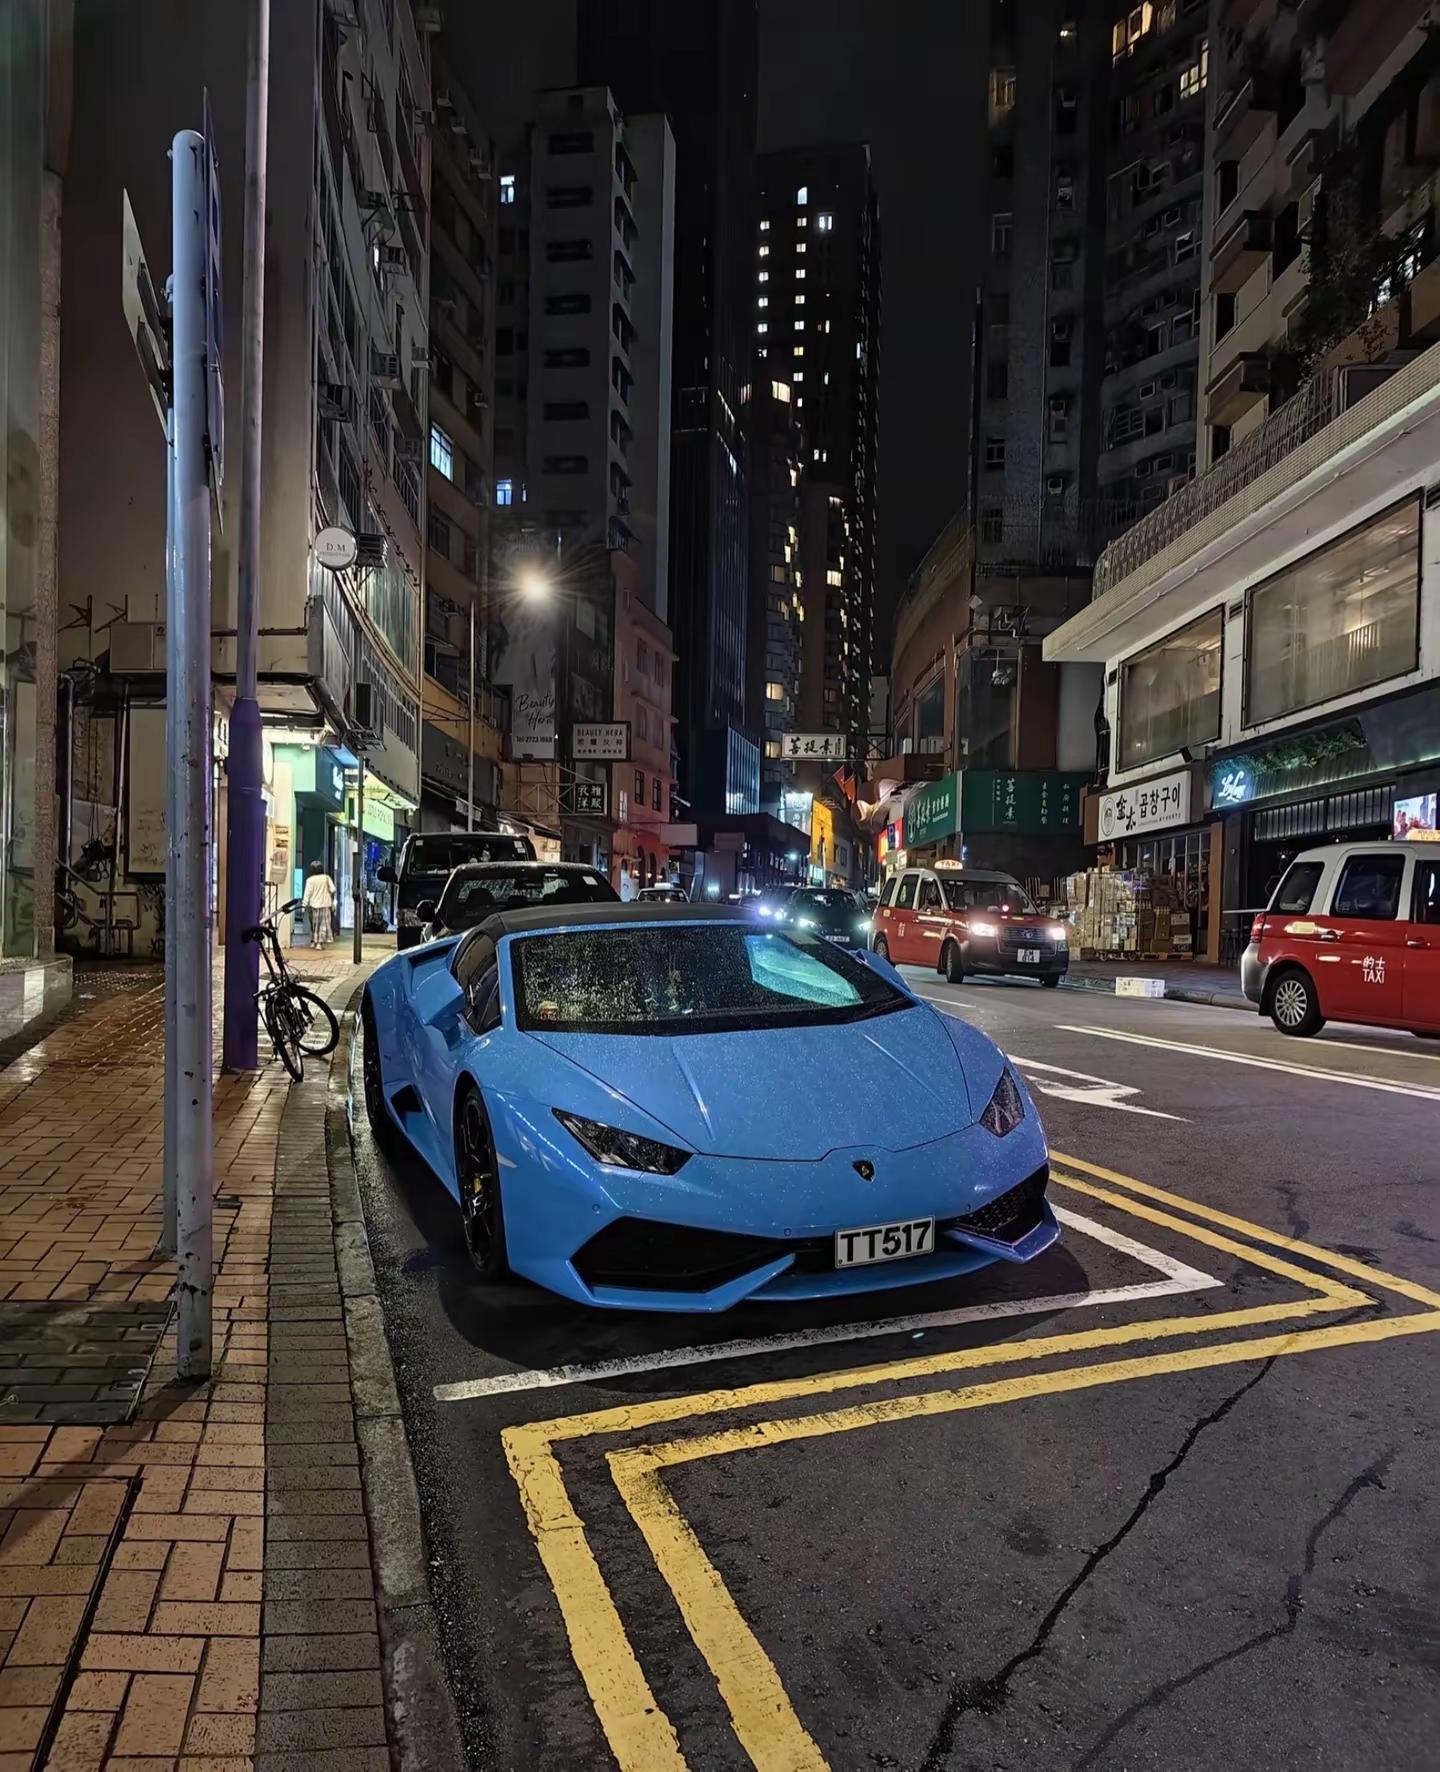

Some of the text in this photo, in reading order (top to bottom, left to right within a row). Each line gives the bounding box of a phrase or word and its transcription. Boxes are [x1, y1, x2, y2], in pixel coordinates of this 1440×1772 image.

[326, 543, 346, 552] D.M
[517, 693, 554, 711] Beauty
[605, 728, 623, 737] HERA
[1139, 782, 1181, 819] 곱창구이
[940, 860, 960, 869] TAXI
[1362, 955, 1386, 970] 的士
[1362, 969, 1385, 984] TAXI
[839, 1220, 932, 1263] TT517
